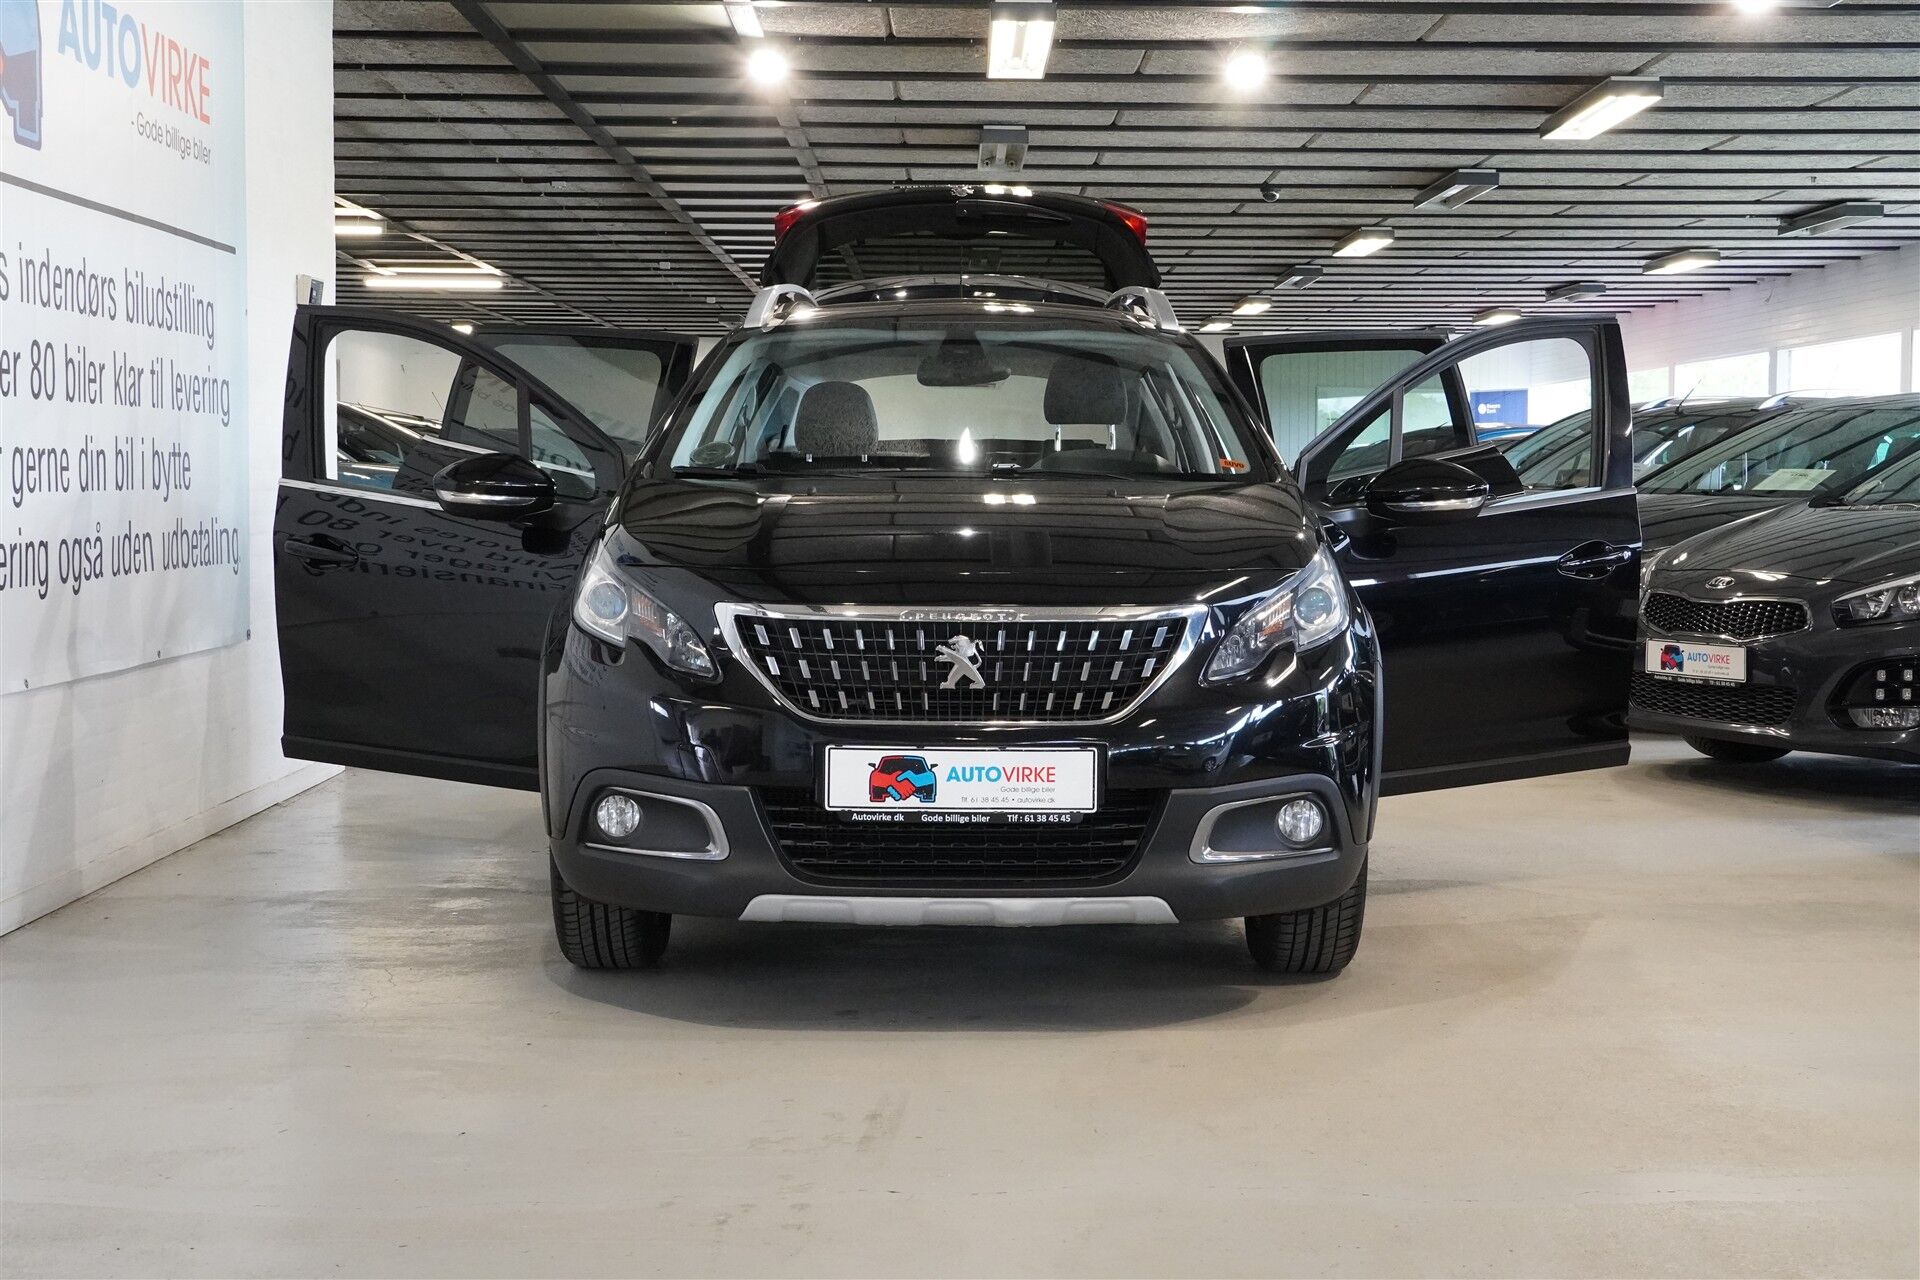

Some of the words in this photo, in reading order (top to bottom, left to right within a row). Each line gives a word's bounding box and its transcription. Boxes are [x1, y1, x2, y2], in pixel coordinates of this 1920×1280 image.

[57, 0, 211, 125] AUTOVIRKE
[136, 111, 164, 144] Gode
[165, 124, 192, 160] billige
[192, 140, 211, 165] biler
[18, 241, 117, 321] indendørs
[124, 267, 215, 350] biludstilling
[30, 340, 56, 401] 80
[64, 343, 106, 404] biler
[113, 350, 145, 408] klar
[150, 357, 164, 409] til
[170, 359, 230, 427] levering
[12, 446, 70, 508] gerne
[79, 435, 107, 492] din
[115, 435, 134, 491] bil
[141, 437, 145, 490] i
[152, 437, 191, 502] bytte
[59, 521, 104, 595] også
[112, 520, 155, 577] uden
[162, 517, 239, 575] udbetaling
[1687, 651, 1730, 665] AUTOVIRKE
[946, 766, 1056, 783] AUTOVIRKE
[852, 813, 892, 822] Autovirke
[921, 814, 943, 823] Gode
[945, 813, 970, 824] billige
[971, 814, 991, 823] biler
[1007, 813, 1018, 823] Tlf
[1024, 813, 1035, 823] 61
[1036, 813, 1047, 823] 38
[1048, 813, 1059, 823] 45
[1060, 813, 1071, 823] 45
